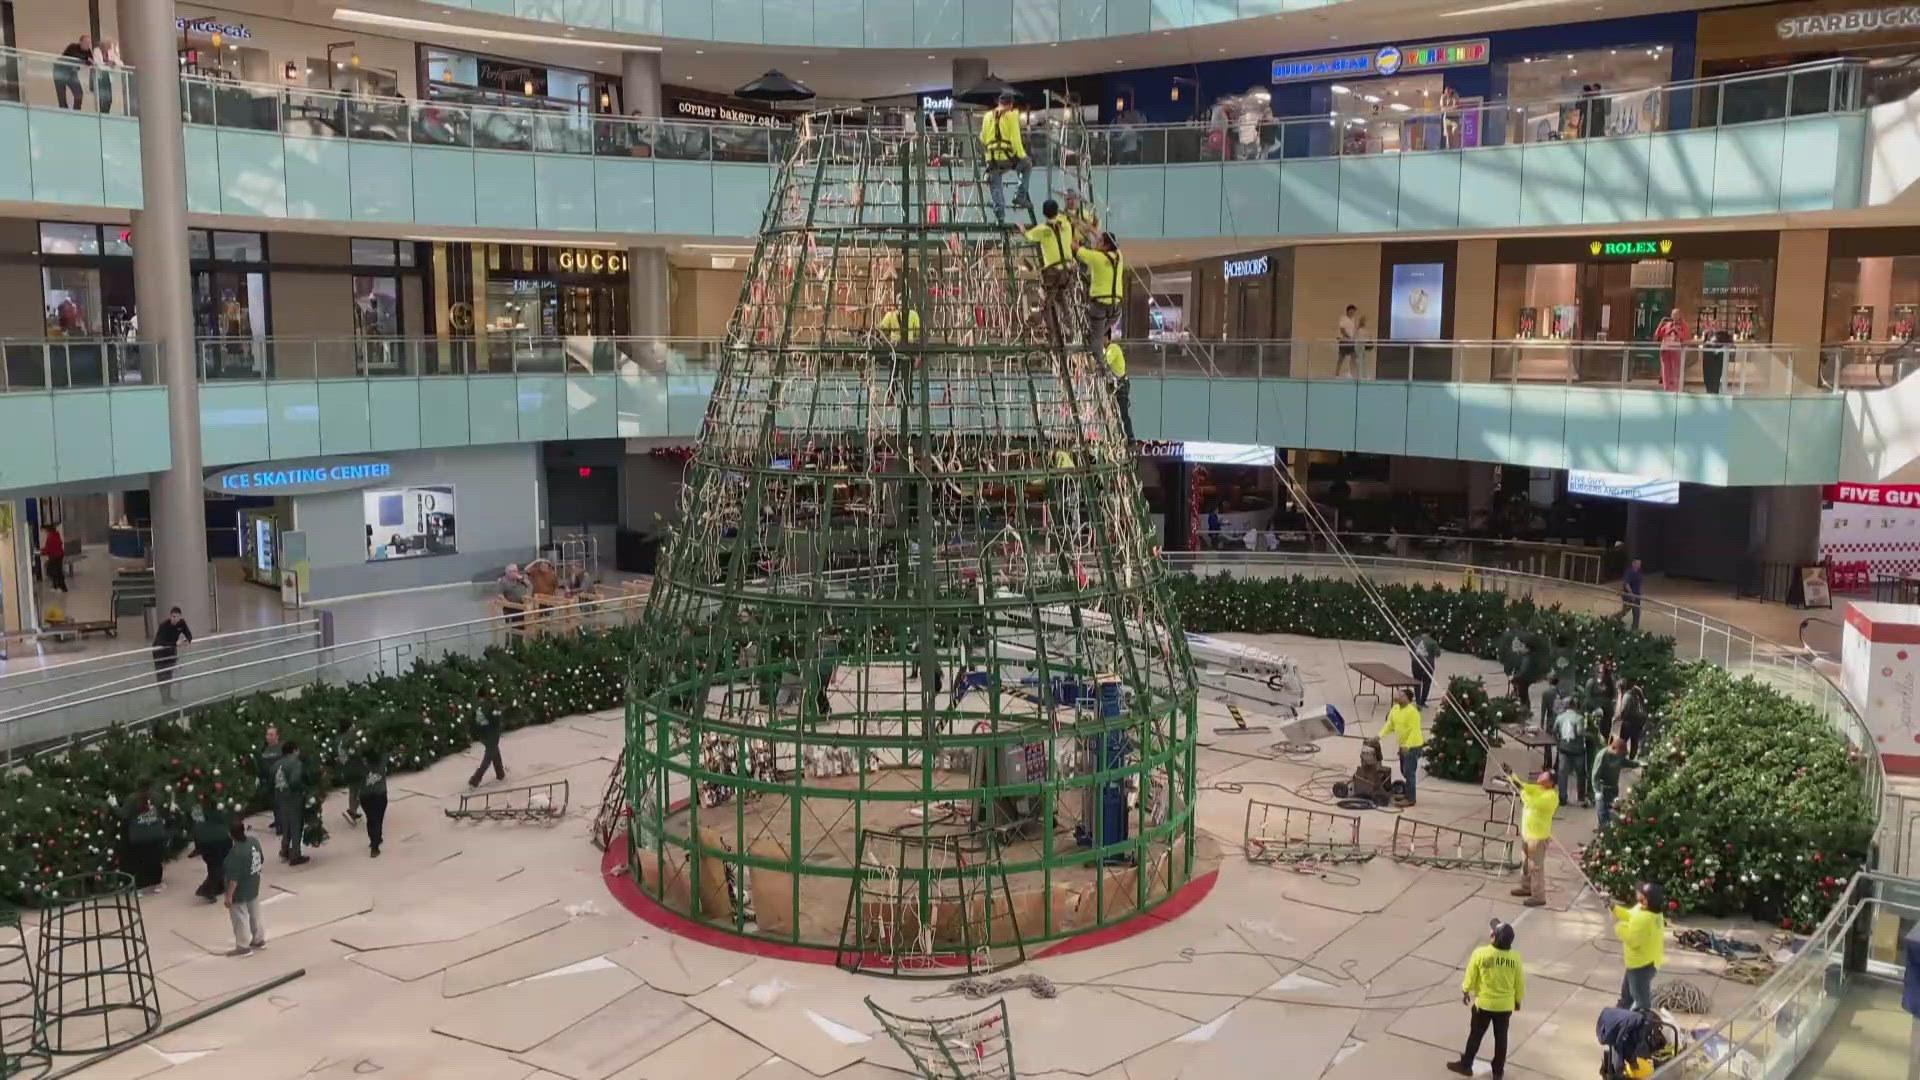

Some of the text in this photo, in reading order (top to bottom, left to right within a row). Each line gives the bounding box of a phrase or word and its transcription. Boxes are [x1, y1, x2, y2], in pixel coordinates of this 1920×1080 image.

[175, 17, 252, 38] ancesca's
[1407, 43, 1485, 65] WORKSHOP
[678, 102, 717, 119] corner
[719, 106, 757, 126] bakery
[1604, 241, 1657, 255] ROLEX
[559, 252, 628, 271] GUCCI
[222, 463, 391, 489] ICE SKATING CENTER
[1840, 486, 1880, 502] FIVE
